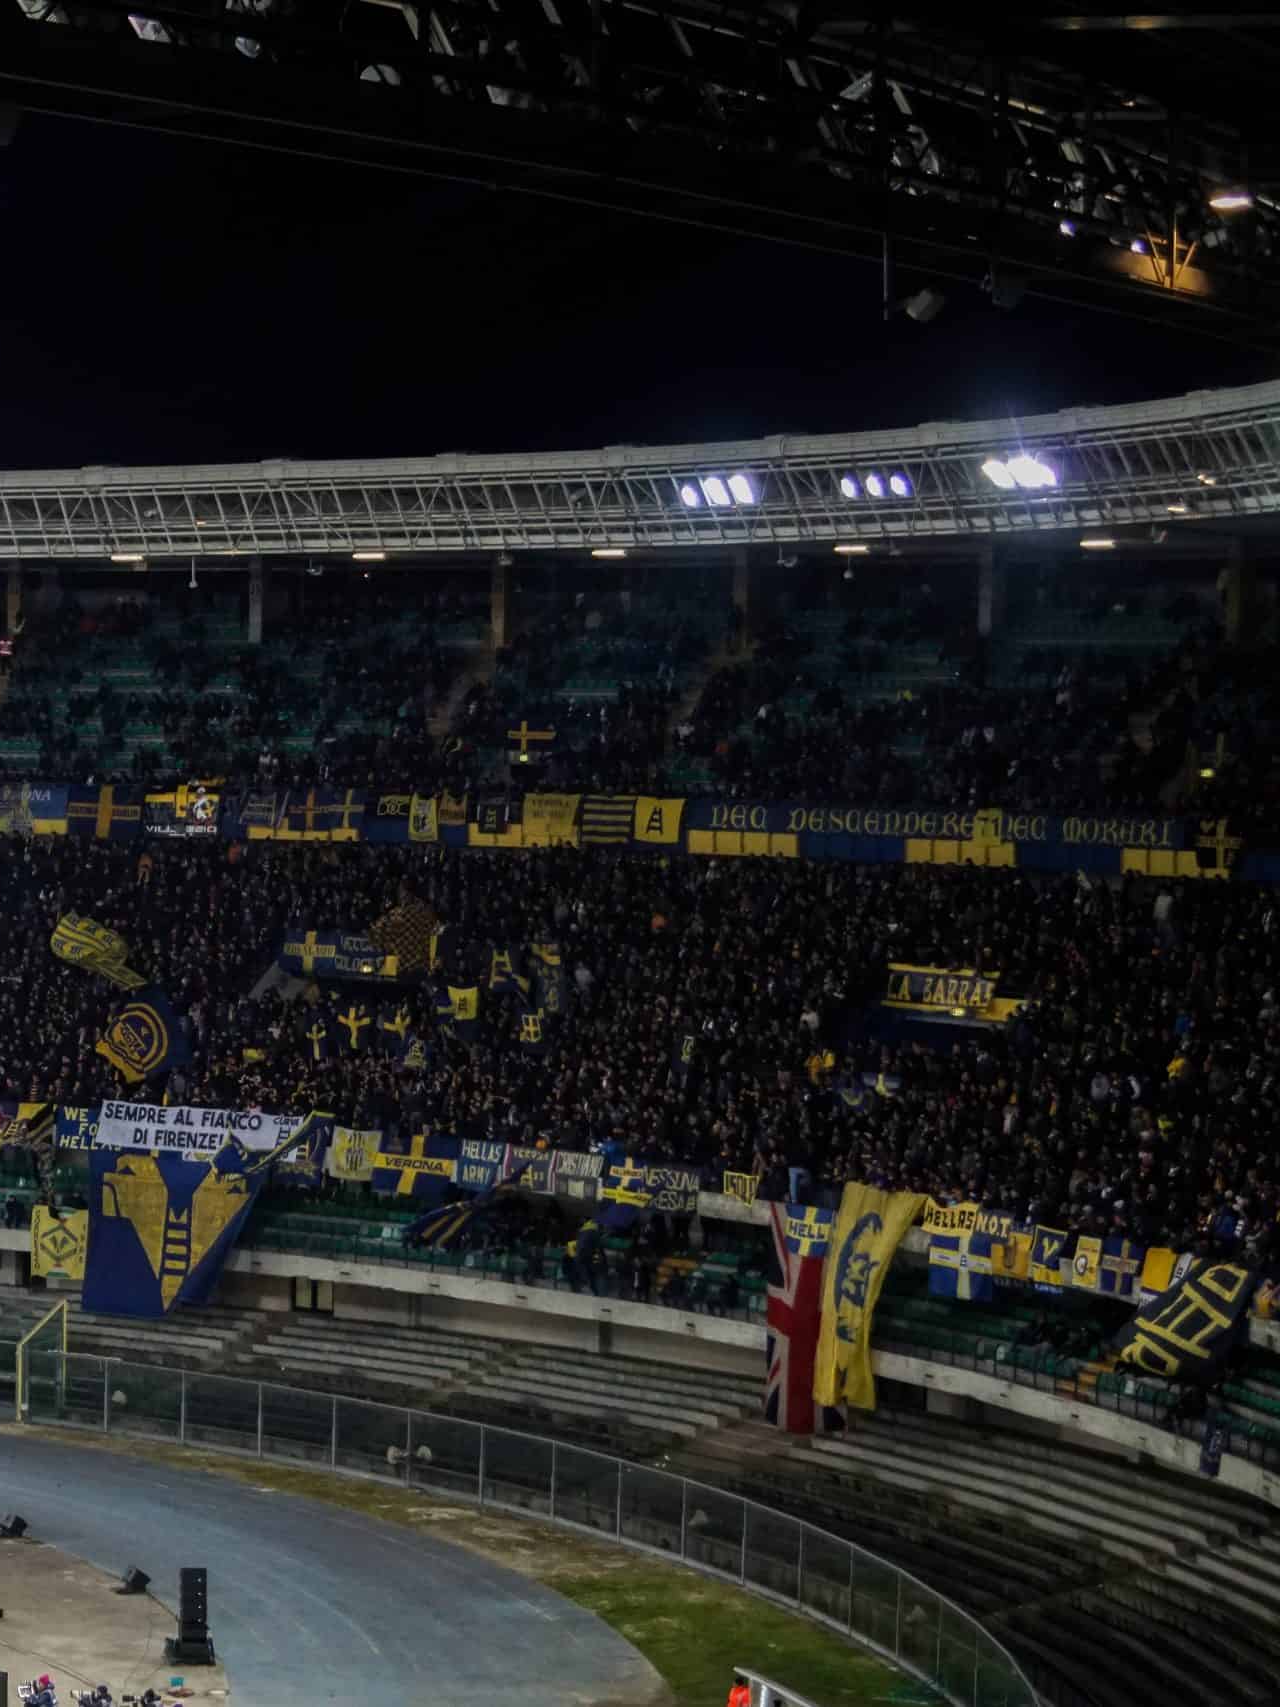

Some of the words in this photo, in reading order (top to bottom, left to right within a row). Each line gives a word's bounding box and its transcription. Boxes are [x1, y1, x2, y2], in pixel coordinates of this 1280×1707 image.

[64, 1105, 89, 1123] WE
[104, 1102, 168, 1125] SEMPRE
[173, 1108, 194, 1126] AL
[201, 1110, 262, 1131] FIANCO
[133, 1127, 149, 1145] DI
[461, 1139, 503, 1163] HELLAS
[384, 1156, 445, 1173] VERONA
